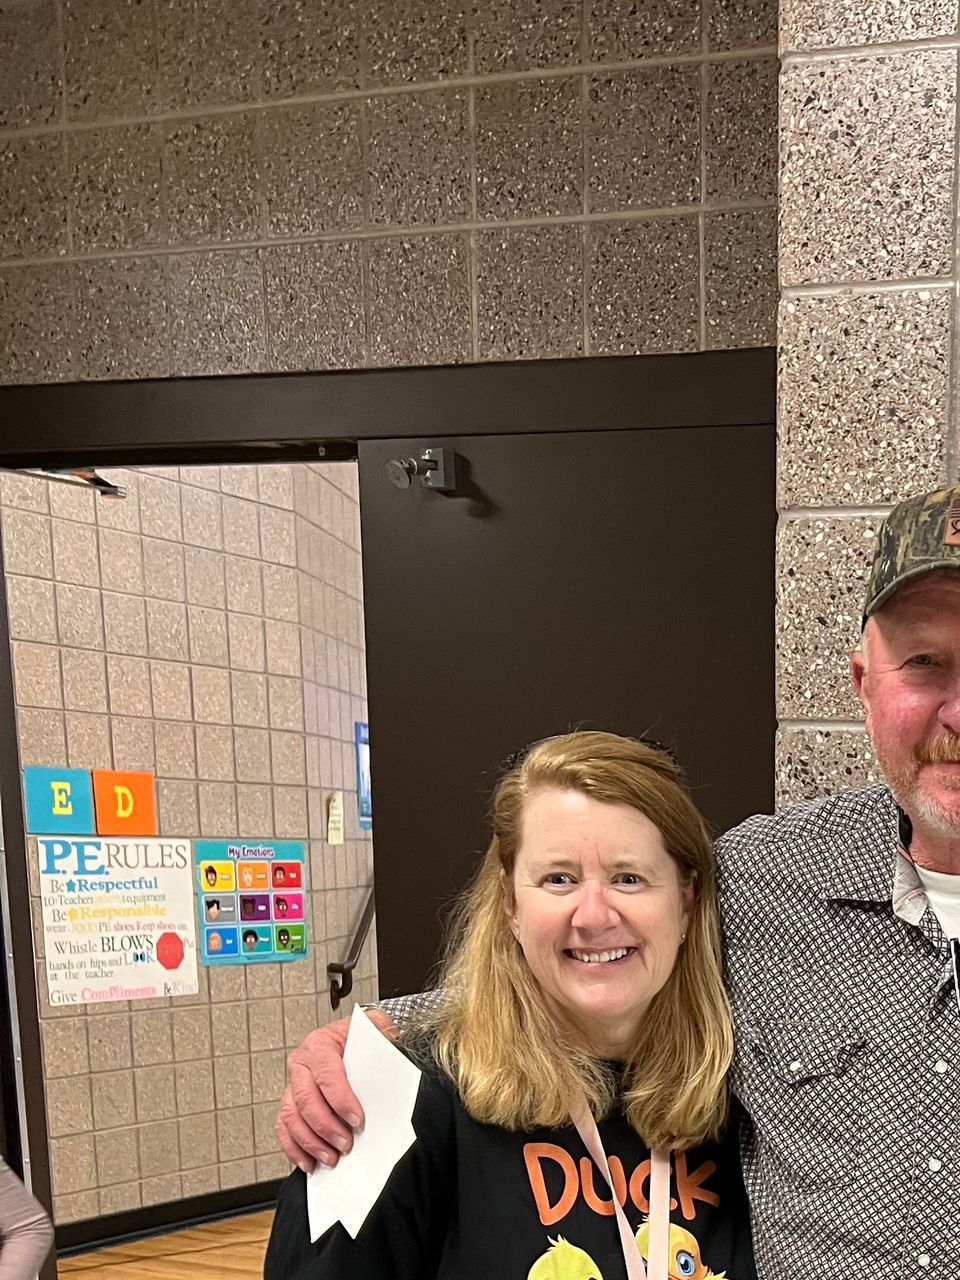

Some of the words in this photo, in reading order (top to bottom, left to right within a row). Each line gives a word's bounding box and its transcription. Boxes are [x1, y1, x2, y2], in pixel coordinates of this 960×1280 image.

[50, 781, 73, 815] E
[114, 786, 134, 817] D
[105, 843, 187, 869] RULES
[228, 847, 240, 859] My
[242, 846, 274, 857] Emotions
[50, 879, 65, 893] Be
[76, 876, 159, 893] Respectful
[58, 894, 94, 906] Teachers
[52, 908, 67, 923] Be
[79, 904, 168, 921] Responsible
[53, 939, 98, 955] Whistle
[100, 934, 154, 953] BLOWS
[90, 957, 107, 972] hips
[108, 956, 122, 967] and
[49, 972, 57, 981] at
[64, 967, 79, 981] the
[85, 967, 114, 980] teacher
[50, 988, 78, 1004] Give
